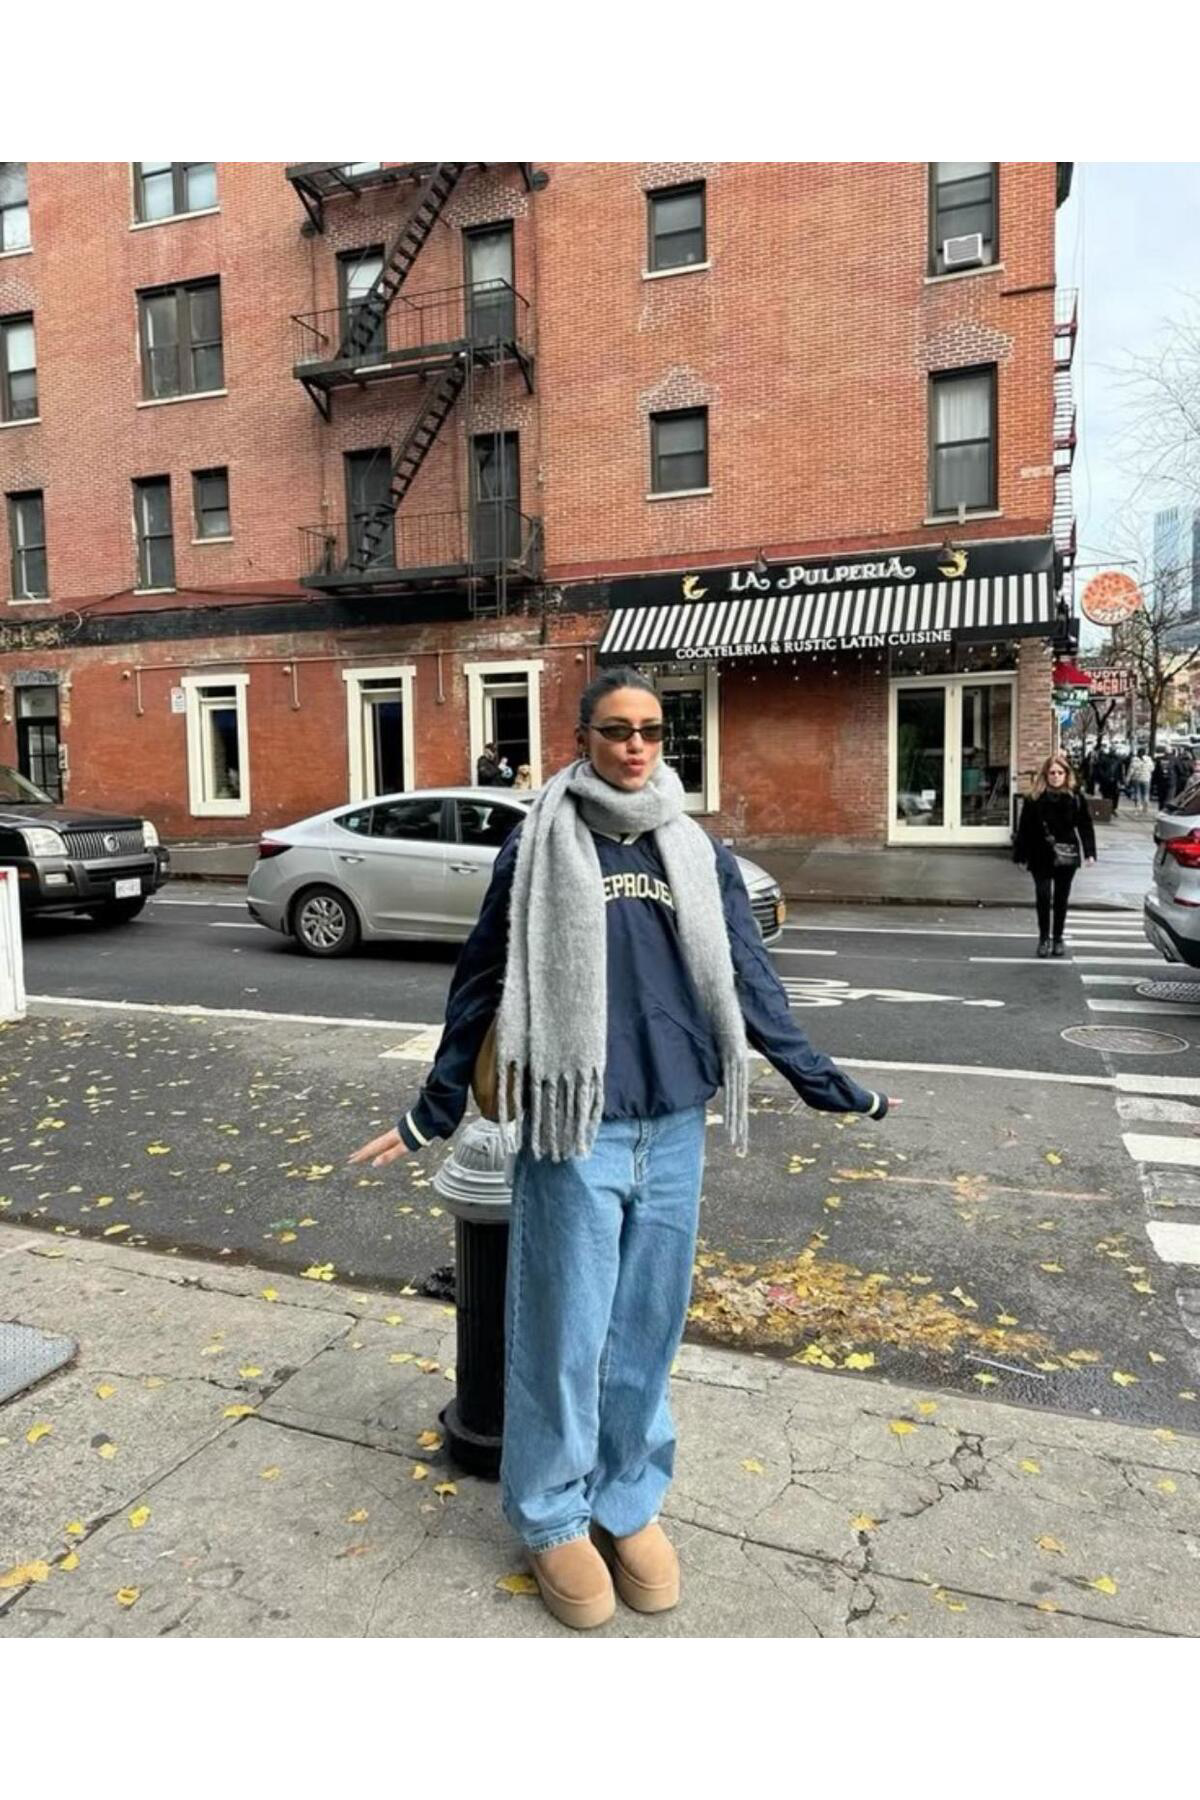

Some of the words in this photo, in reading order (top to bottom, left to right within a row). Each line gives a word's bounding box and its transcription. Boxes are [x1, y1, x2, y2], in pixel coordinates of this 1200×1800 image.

[728, 571, 771, 591] LA
[776, 556, 917, 589] PULPERIA
[675, 644, 768, 660] COCKTELERIA
[770, 641, 781, 654] &
[783, 638, 837, 653] RUSTIC
[840, 634, 885, 650] LATIN
[888, 629, 952, 646] CUISINE
